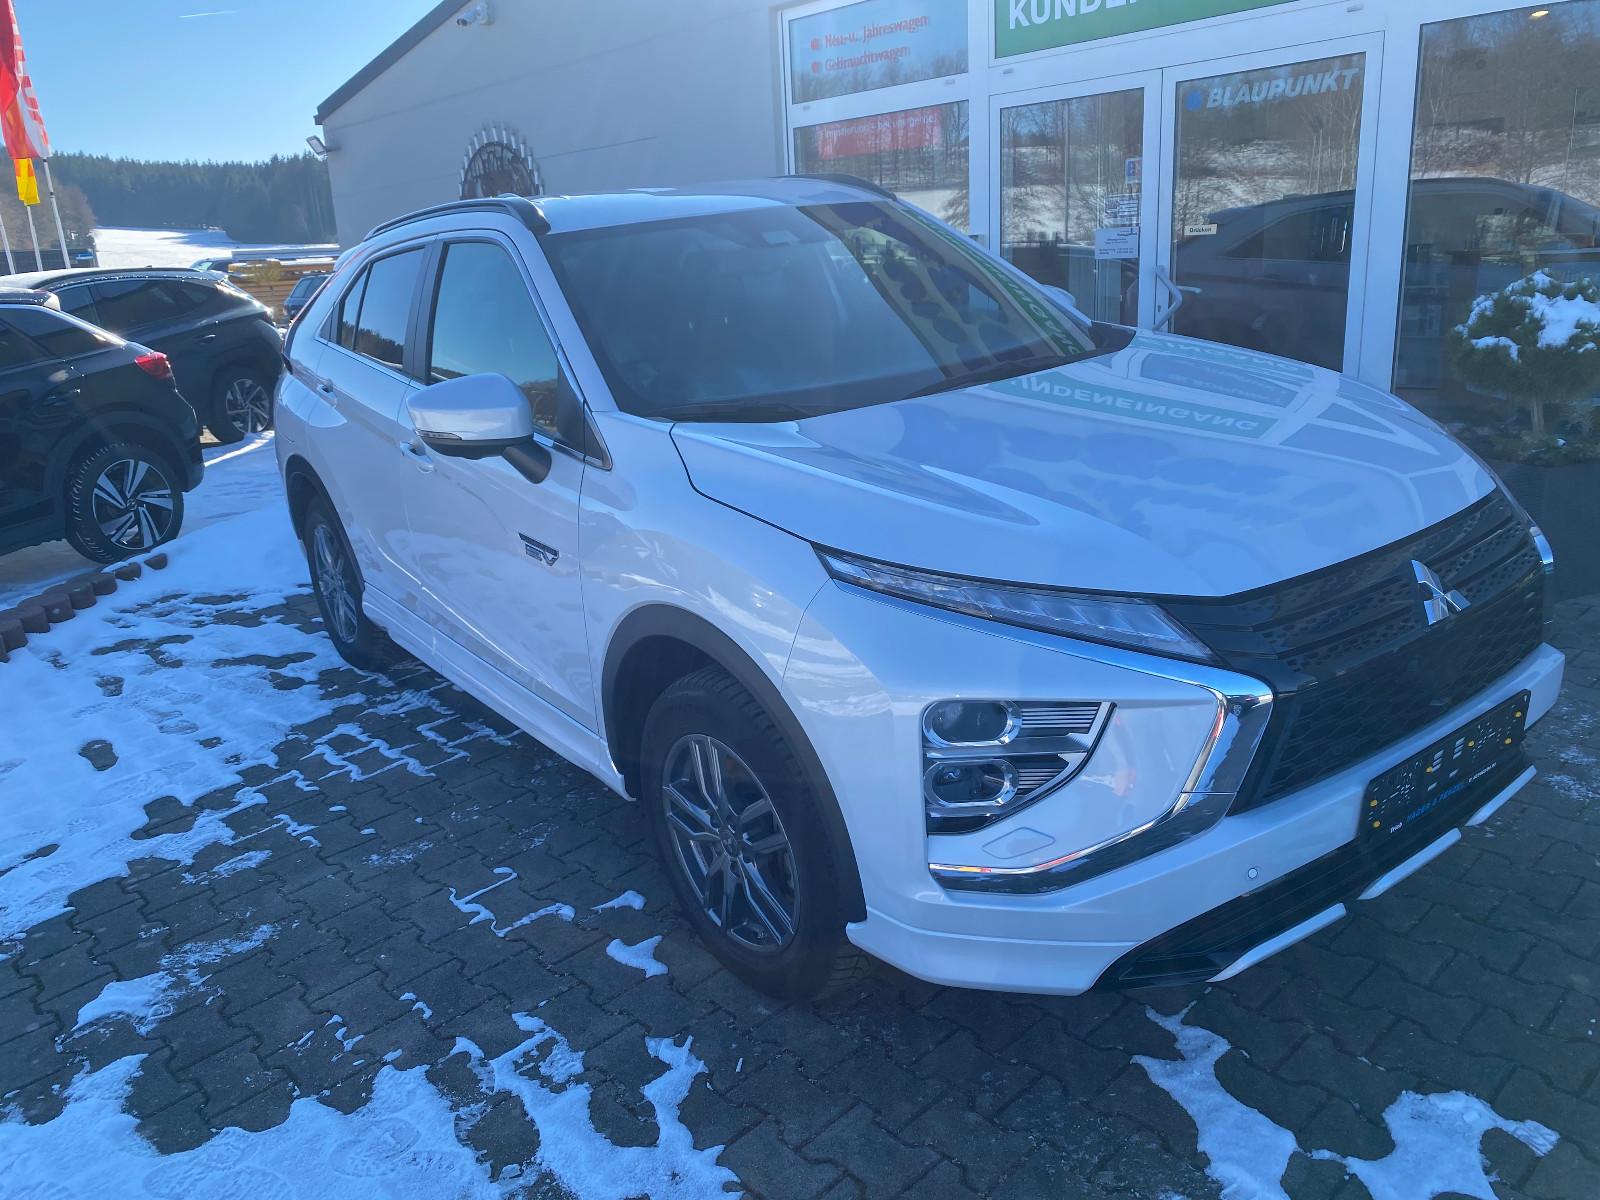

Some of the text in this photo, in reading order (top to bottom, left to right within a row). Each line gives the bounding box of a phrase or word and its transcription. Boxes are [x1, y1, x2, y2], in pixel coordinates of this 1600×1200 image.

[863, 15, 930, 43] Jahreswagen
[1010, 0, 1137, 30] KUN
[825, 46, 911, 71] Gebrauchtwagen
[1206, 68, 1360, 108] BLAUPUNKT
